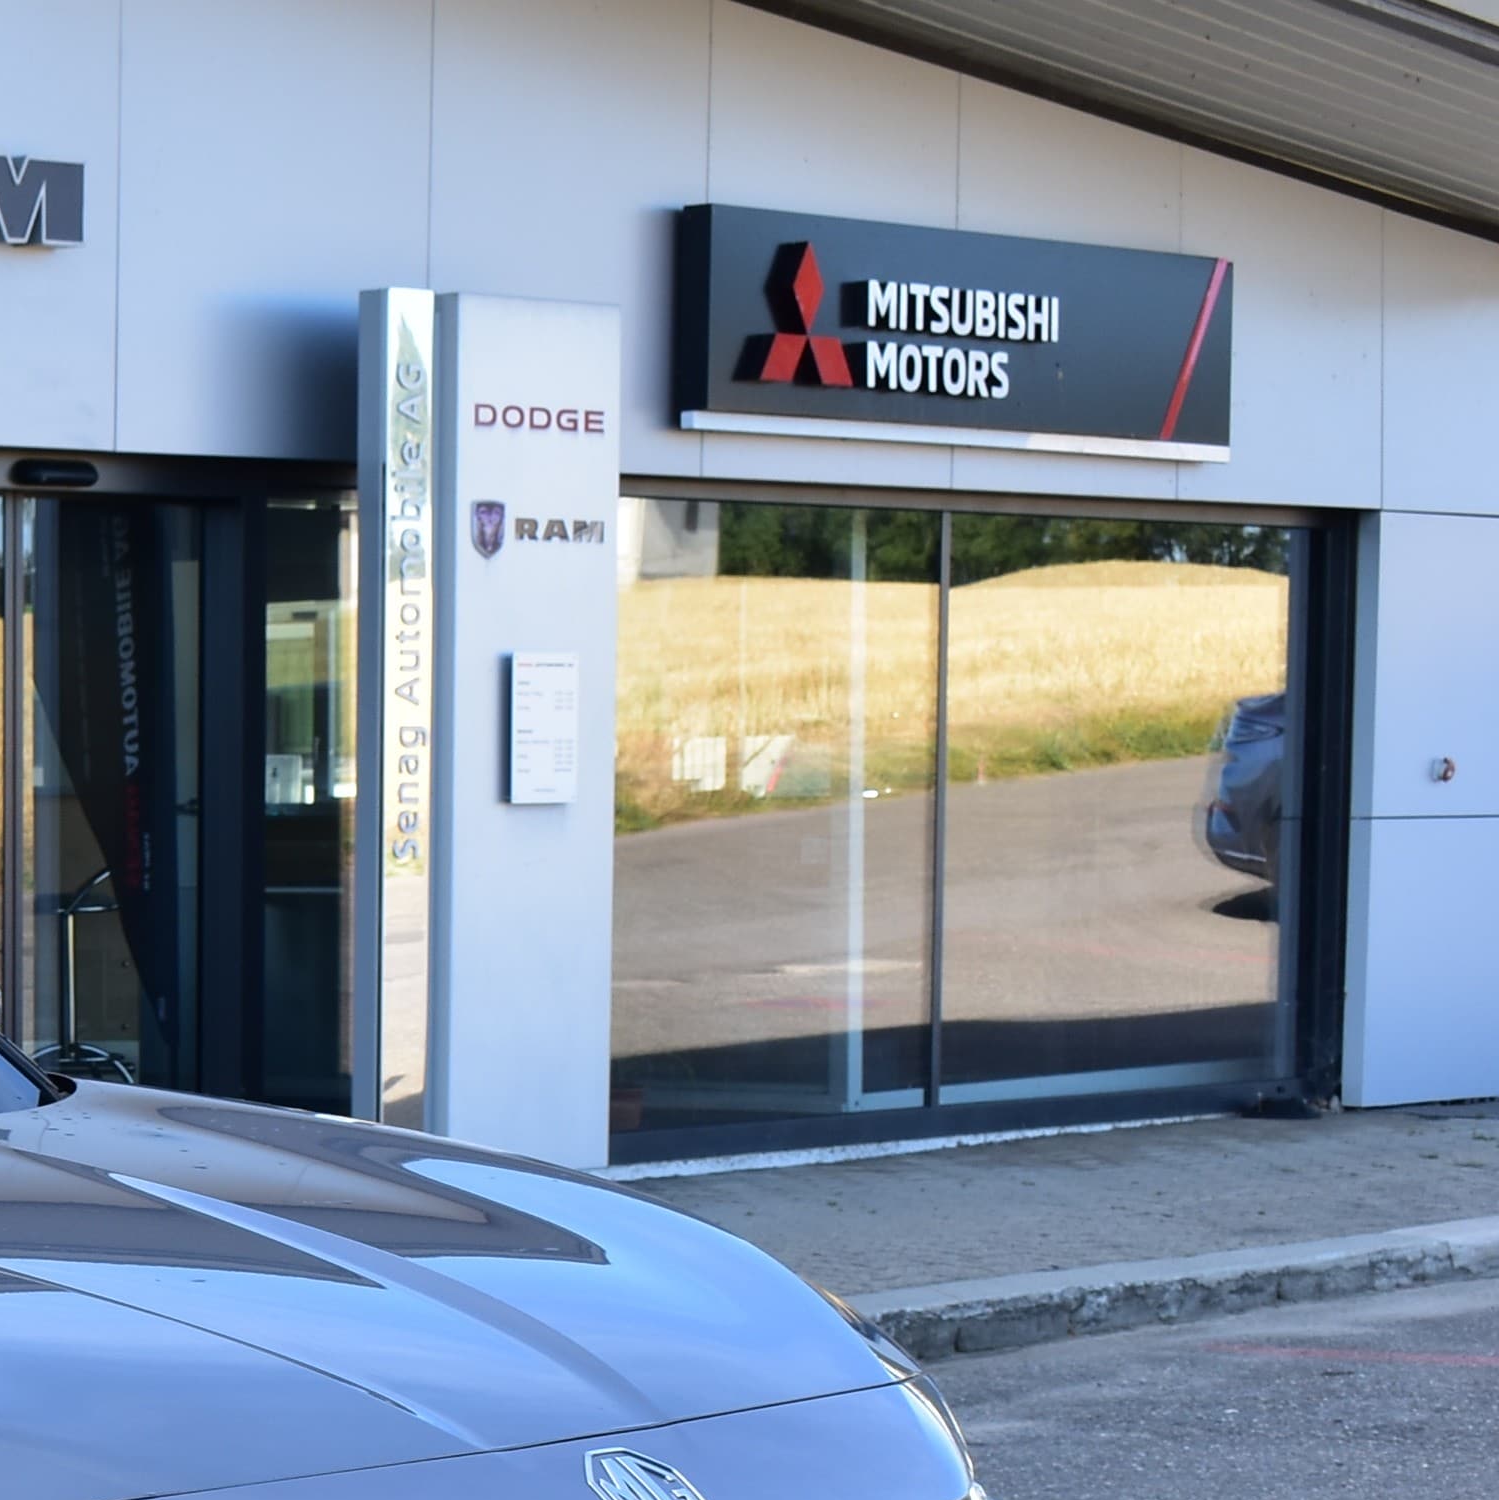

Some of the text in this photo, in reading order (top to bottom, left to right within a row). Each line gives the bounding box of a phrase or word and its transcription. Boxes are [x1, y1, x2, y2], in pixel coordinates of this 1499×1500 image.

[867, 279, 1059, 342] MITSUBISHI
[867, 341, 1009, 399] MOTORS
[474, 403, 605, 433] DODGE
[515, 517, 606, 544] RAM
[391, 363, 427, 860] Senag Automobile AG
